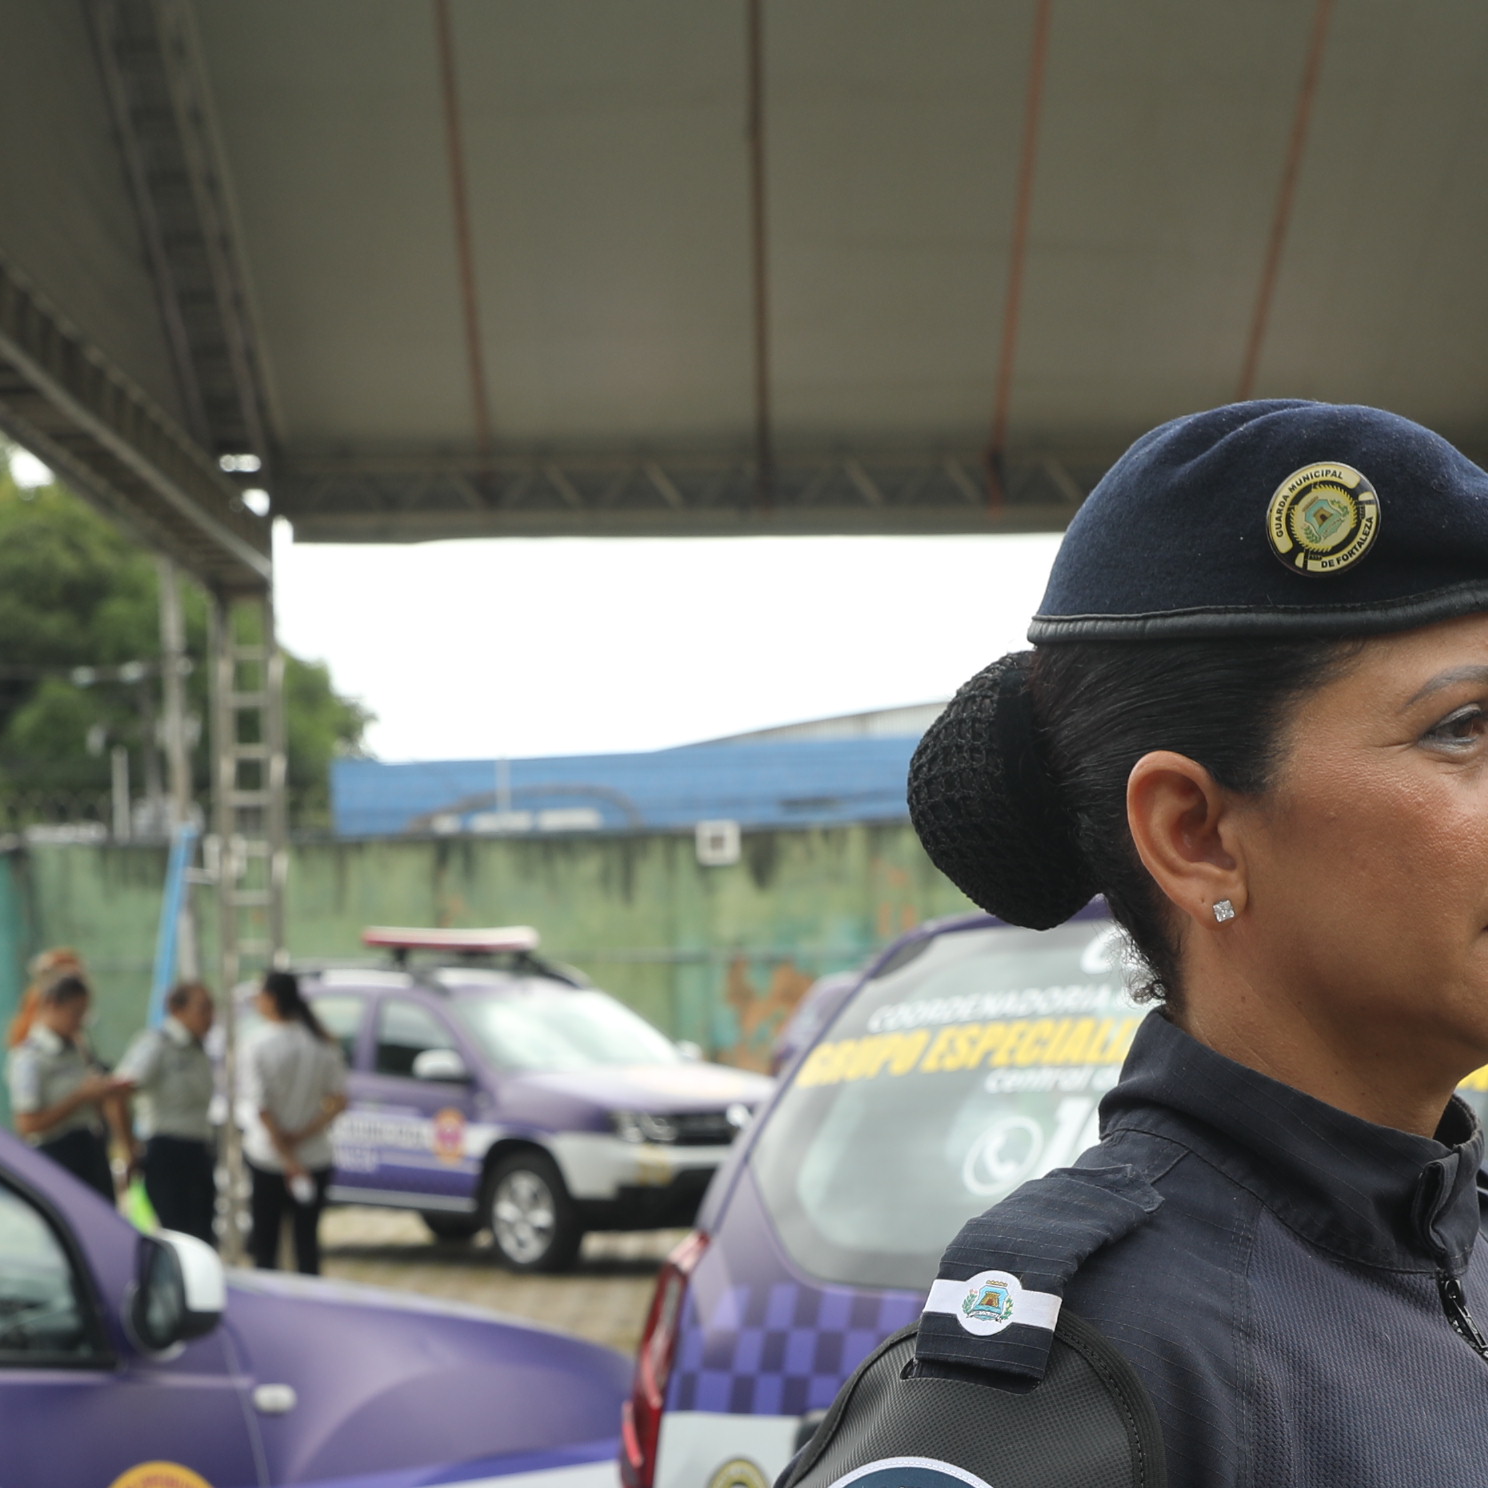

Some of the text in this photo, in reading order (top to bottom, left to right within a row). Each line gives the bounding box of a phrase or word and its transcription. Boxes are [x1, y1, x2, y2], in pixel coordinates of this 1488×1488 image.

[1276, 469, 1344, 538] GUARDA MUNICIPAL
[1321, 515, 1374, 569] DE FORTALEZA
[865, 984, 1114, 1035] COORDENADORIA
[795, 1031, 930, 1089] GRUPO
[921, 1017, 1140, 1074] ESPECIALI
